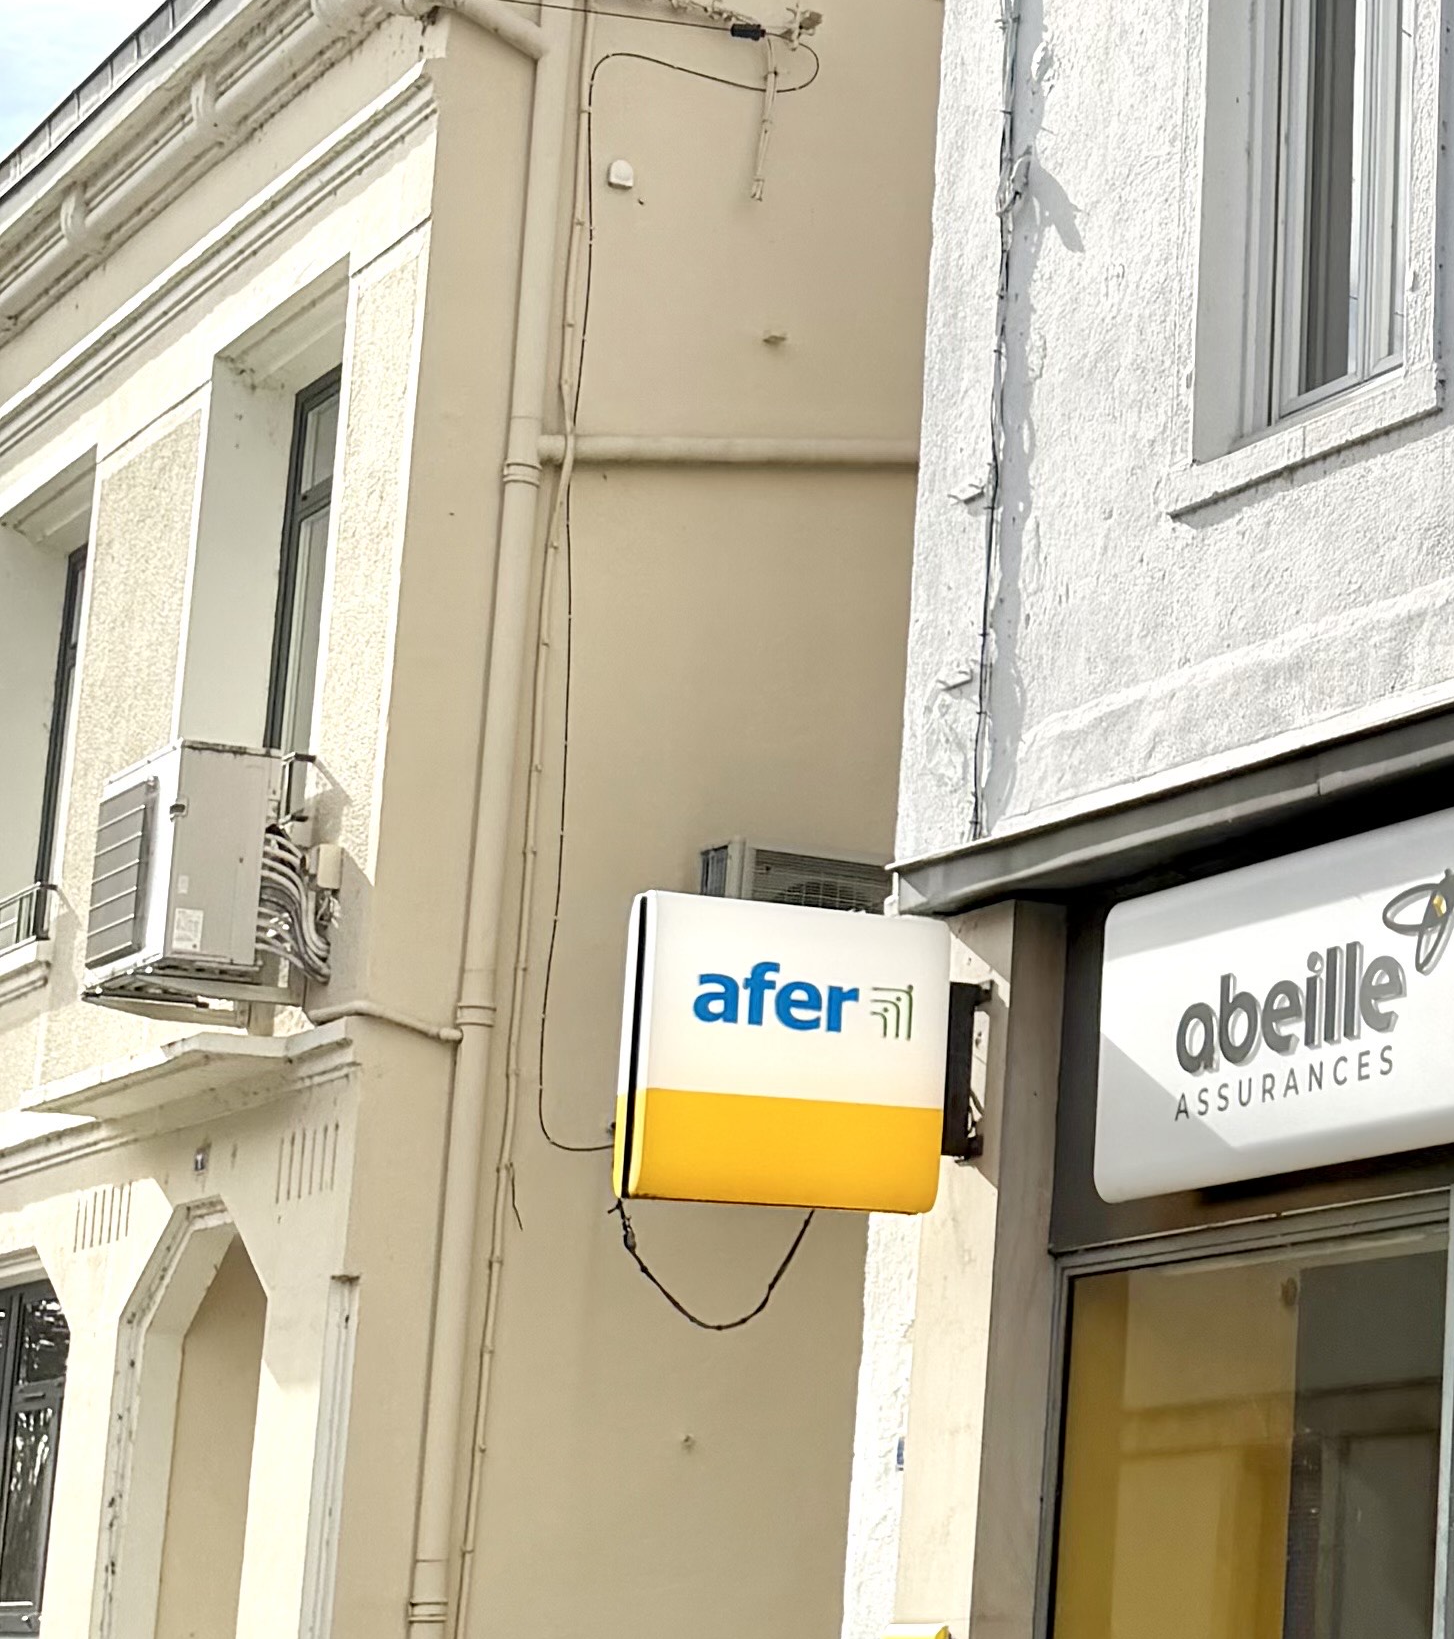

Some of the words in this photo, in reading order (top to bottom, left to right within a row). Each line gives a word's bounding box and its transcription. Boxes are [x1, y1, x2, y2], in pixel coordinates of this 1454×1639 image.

[692, 961, 860, 1033] afer
[1176, 941, 1407, 1077] abeille
[1174, 1045, 1393, 1122] ASSURANCES
